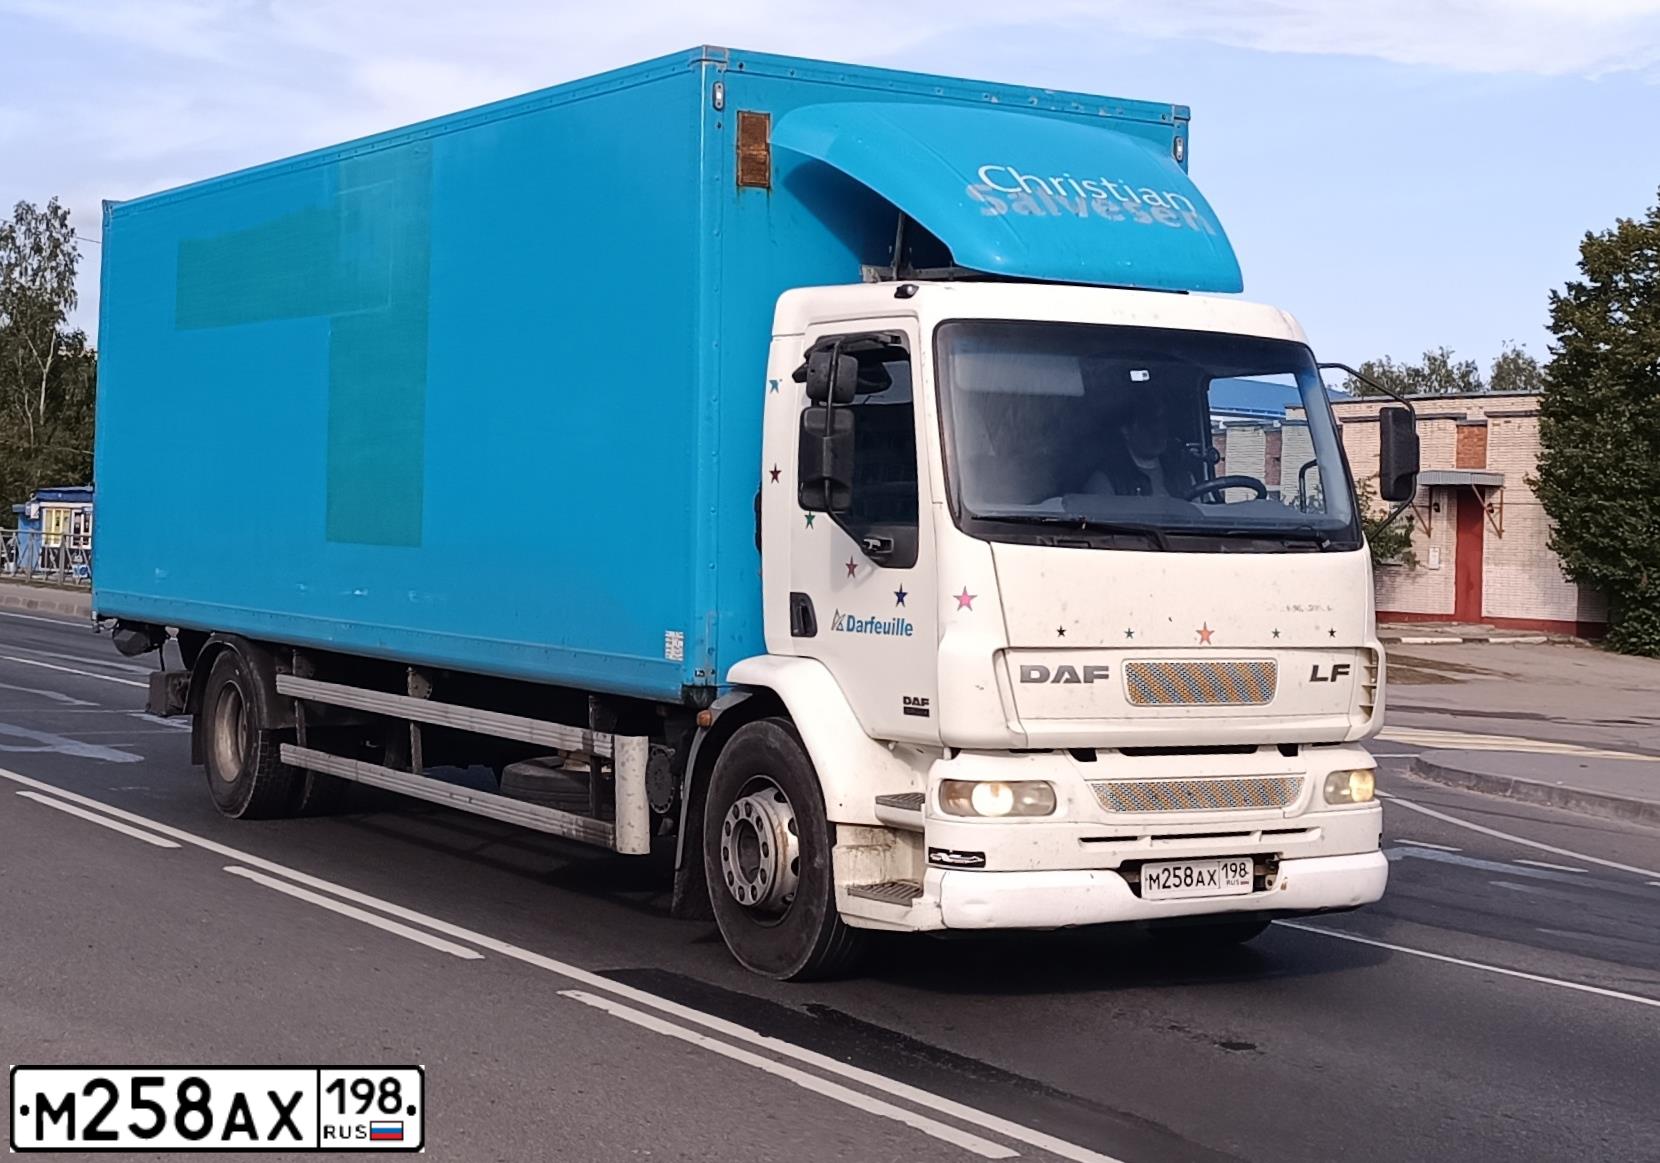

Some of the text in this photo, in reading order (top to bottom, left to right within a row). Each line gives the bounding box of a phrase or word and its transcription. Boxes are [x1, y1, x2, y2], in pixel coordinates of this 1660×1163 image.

[978, 164, 1197, 217] Christian
[847, 615, 913, 636] Darfeuille
[1020, 665, 1109, 684] DAF
[1309, 665, 1350, 682] LF
[903, 696, 929, 706] DAF
[1221, 862, 1247, 879] 198
